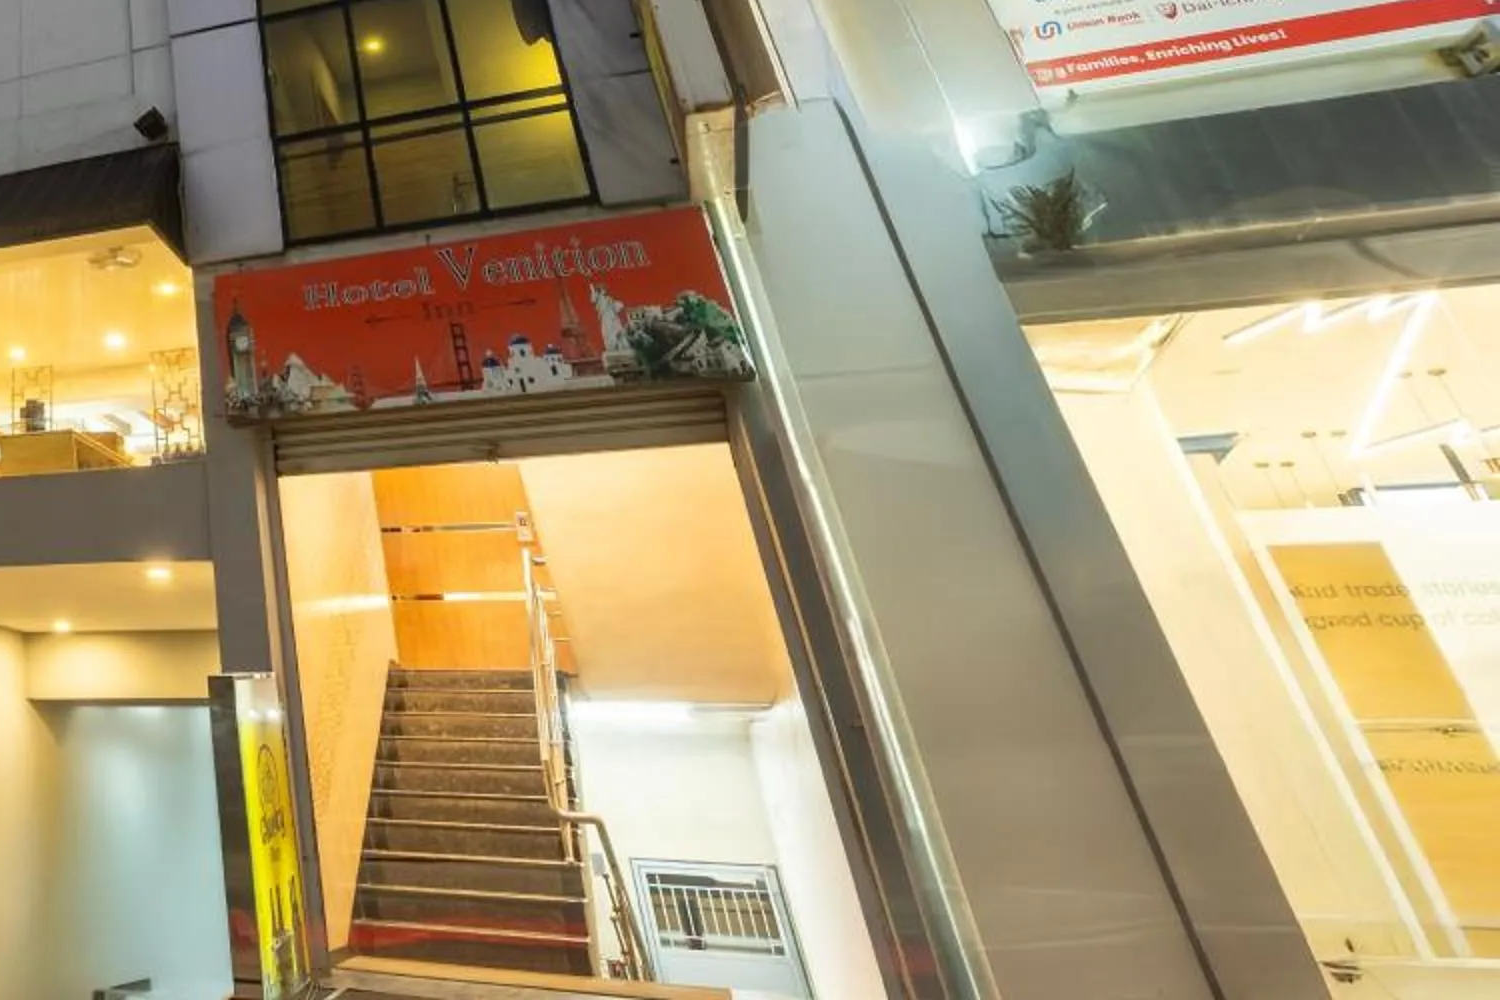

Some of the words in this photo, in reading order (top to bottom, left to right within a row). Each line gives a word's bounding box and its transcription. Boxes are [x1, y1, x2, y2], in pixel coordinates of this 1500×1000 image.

[1147, 38, 1232, 61] Enriching
[1233, 28, 1288, 50] Lives!
[303, 266, 435, 312] Hotel
[436, 233, 652, 292] Venition
